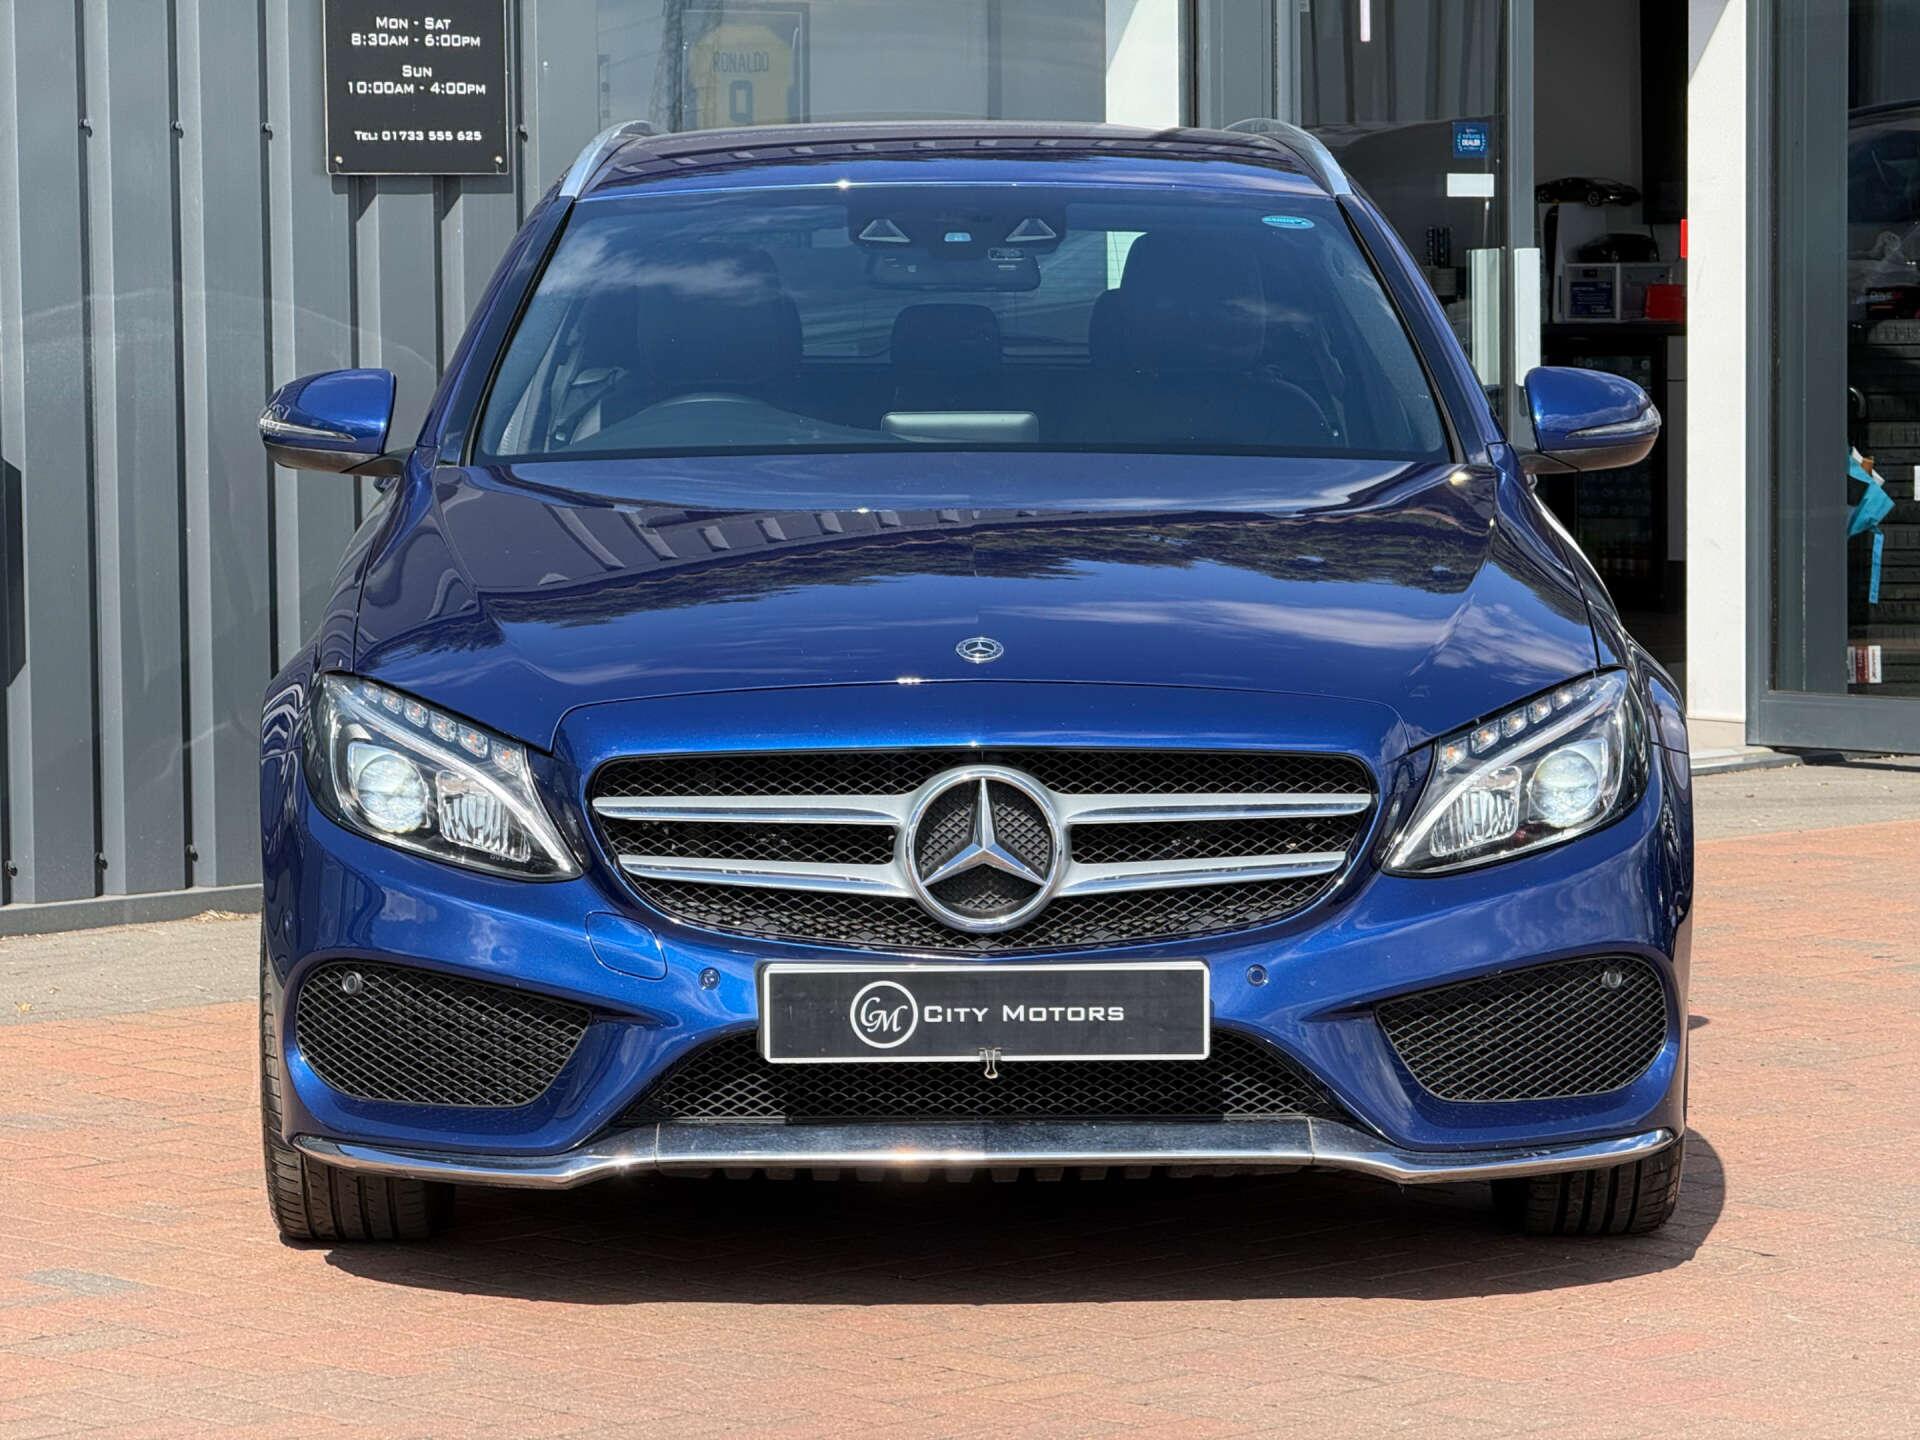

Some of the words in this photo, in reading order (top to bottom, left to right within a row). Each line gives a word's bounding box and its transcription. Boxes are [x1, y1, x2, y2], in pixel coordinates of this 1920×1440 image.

[713, 50, 769, 73] RONALDO
[402, 64, 433, 78] SUN
[381, 130, 425, 141] 01733
[427, 130, 454, 141] 555
[456, 130, 483, 141] 625
